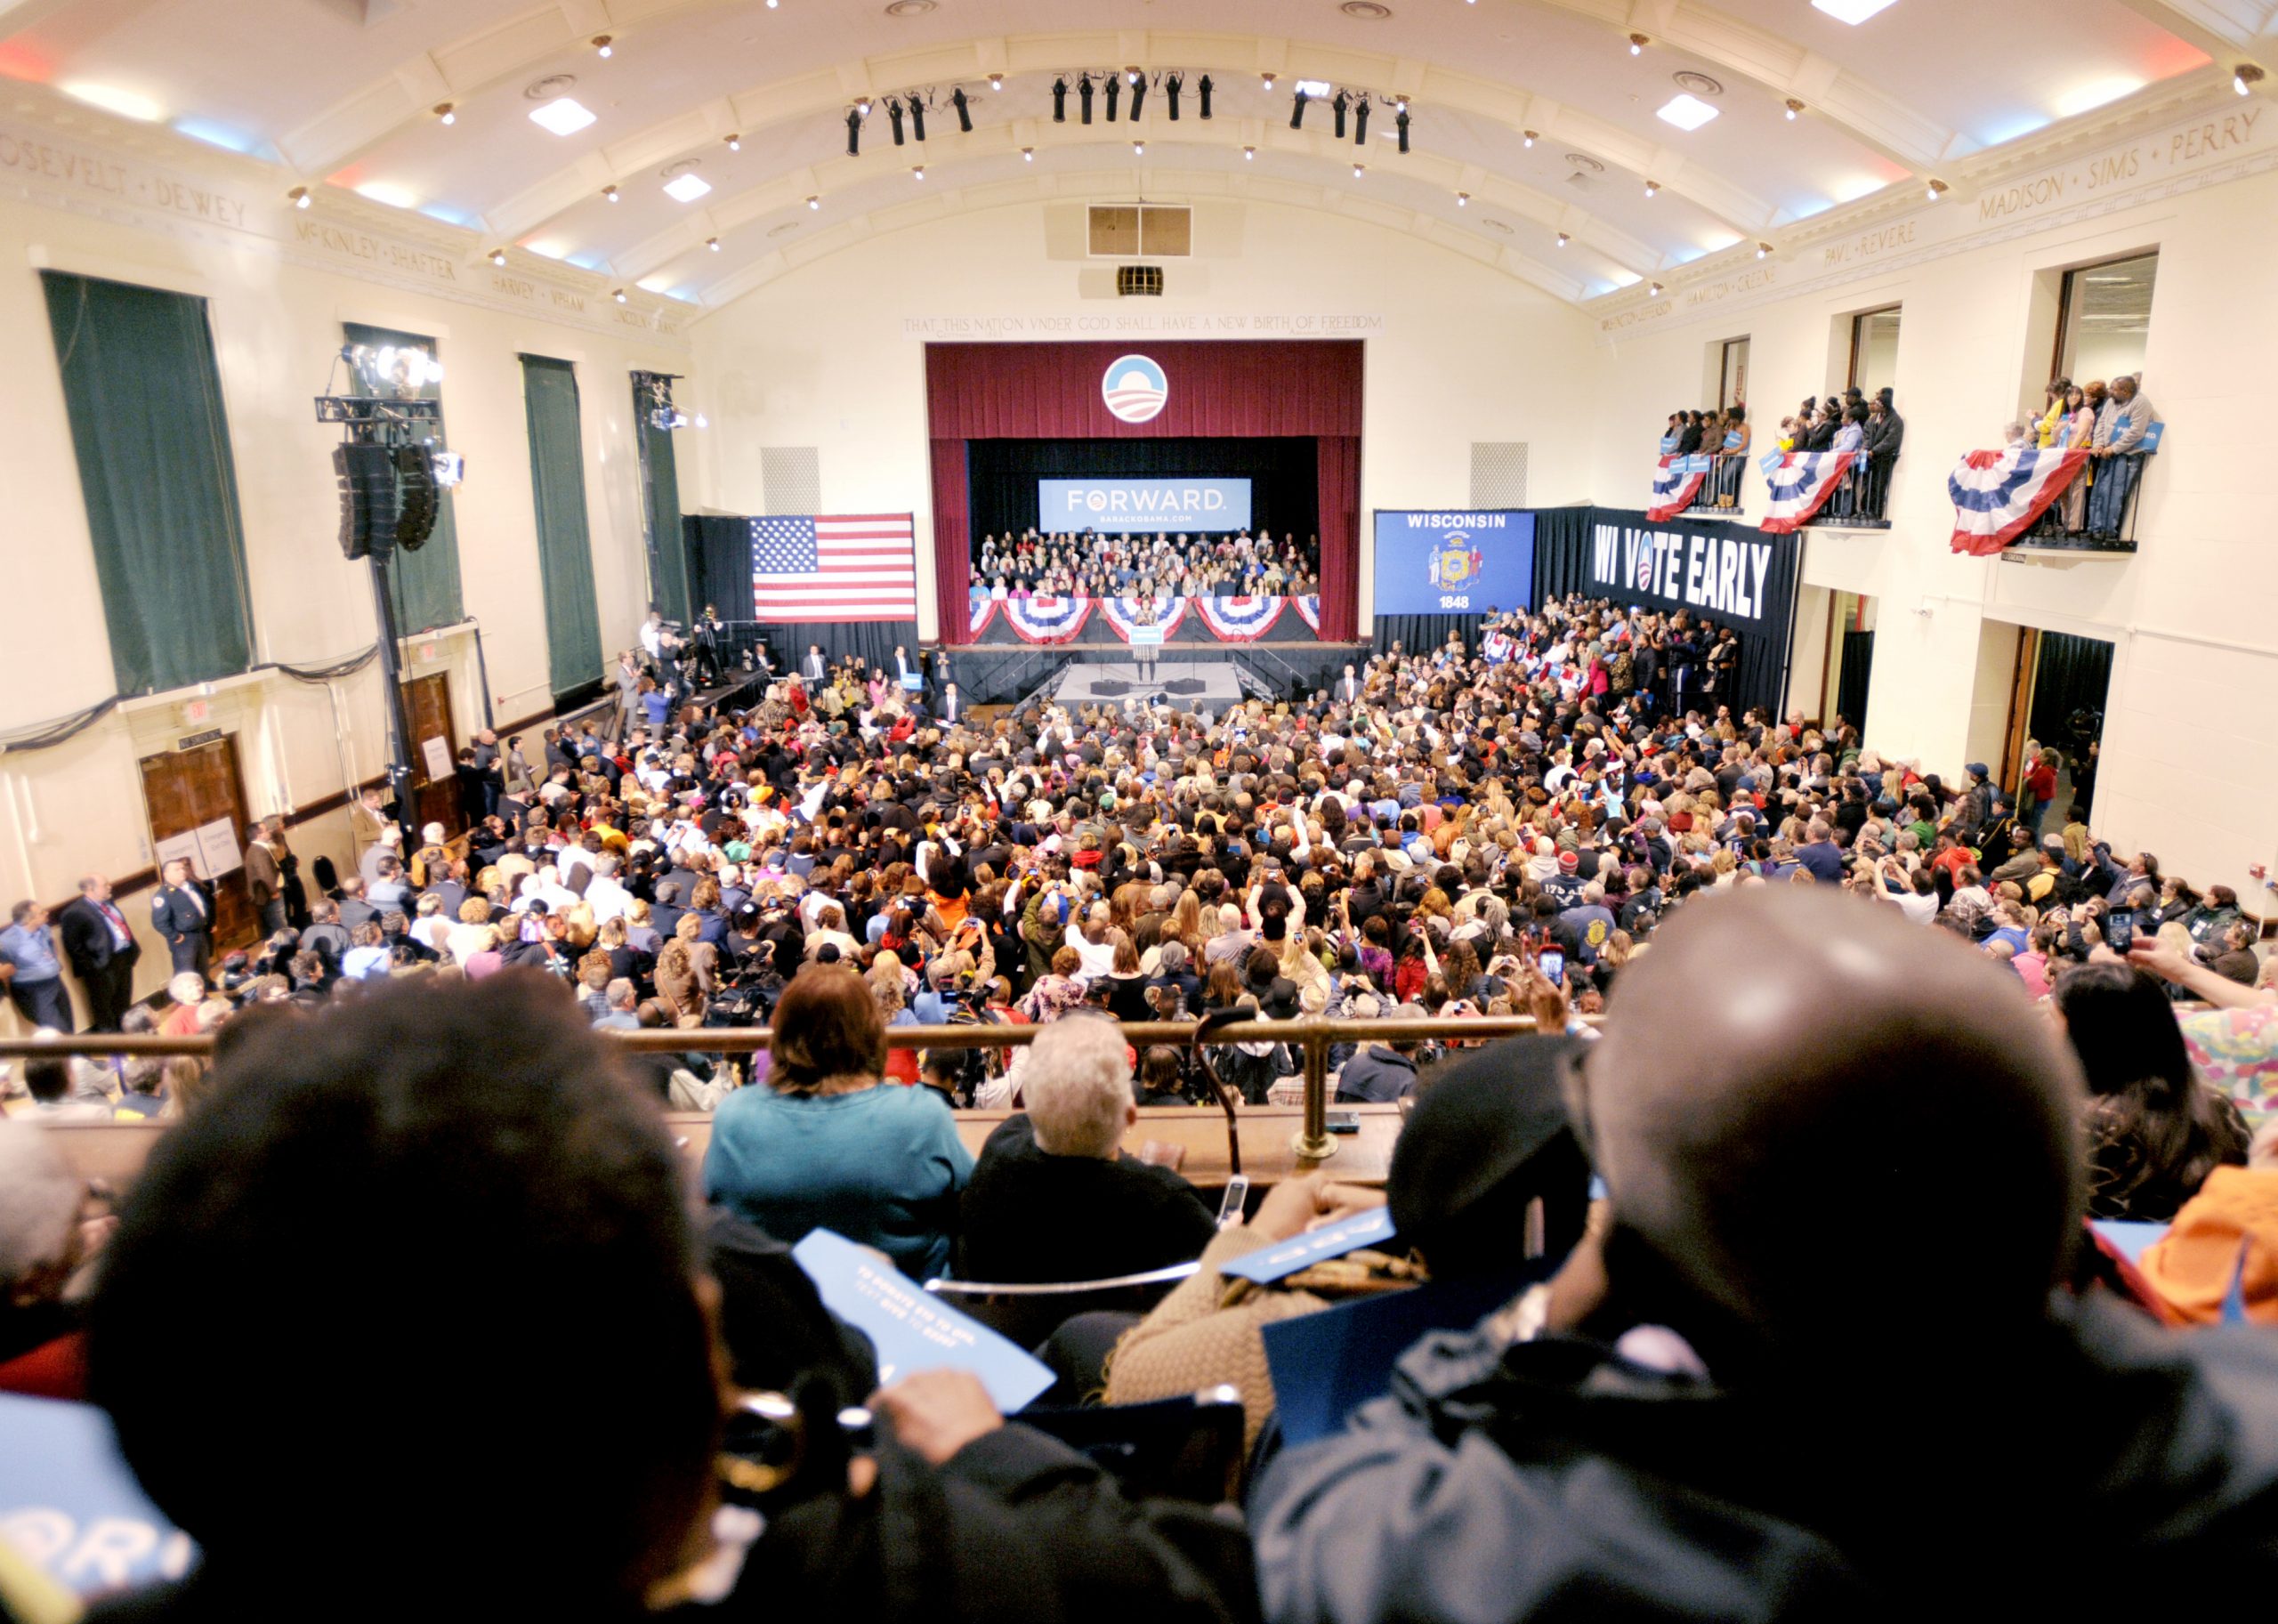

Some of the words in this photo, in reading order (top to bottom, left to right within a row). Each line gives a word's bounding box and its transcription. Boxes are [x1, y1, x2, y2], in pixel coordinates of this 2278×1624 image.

[1979, 173, 2064, 222] MADISON
[2088, 149, 2139, 190] SIMS
[2169, 107, 2262, 165] PERRY
[155, 177, 246, 227] DEWEY
[1861, 221, 1917, 257] REVERE
[390, 246, 456, 281] SHAFTER
[903, 318, 935, 332] THAT
[943, 317, 970, 331] THIS
[975, 317, 1023, 331] NATION
[1078, 316, 1111, 330] GOD
[1116, 316, 1155, 330] SHALL
[1162, 316, 1196, 330] HAVE
[1202, 316, 1211, 329] A
[1217, 316, 1248, 329] NEW
[1254, 315, 1290, 329] BIRTH
[1296, 315, 1315, 329] OF
[1321, 315, 1383, 329] FREEDOM
[1100, 515, 1192, 523] BARACKOBAMA.COM
[1407, 513, 1507, 529] WISCONSIN
[1595, 524, 1619, 586] WI
[1625, 528, 1684, 601] VOTE
[1685, 535, 1773, 619] EARLY
[1438, 595, 1469, 609] 1848
